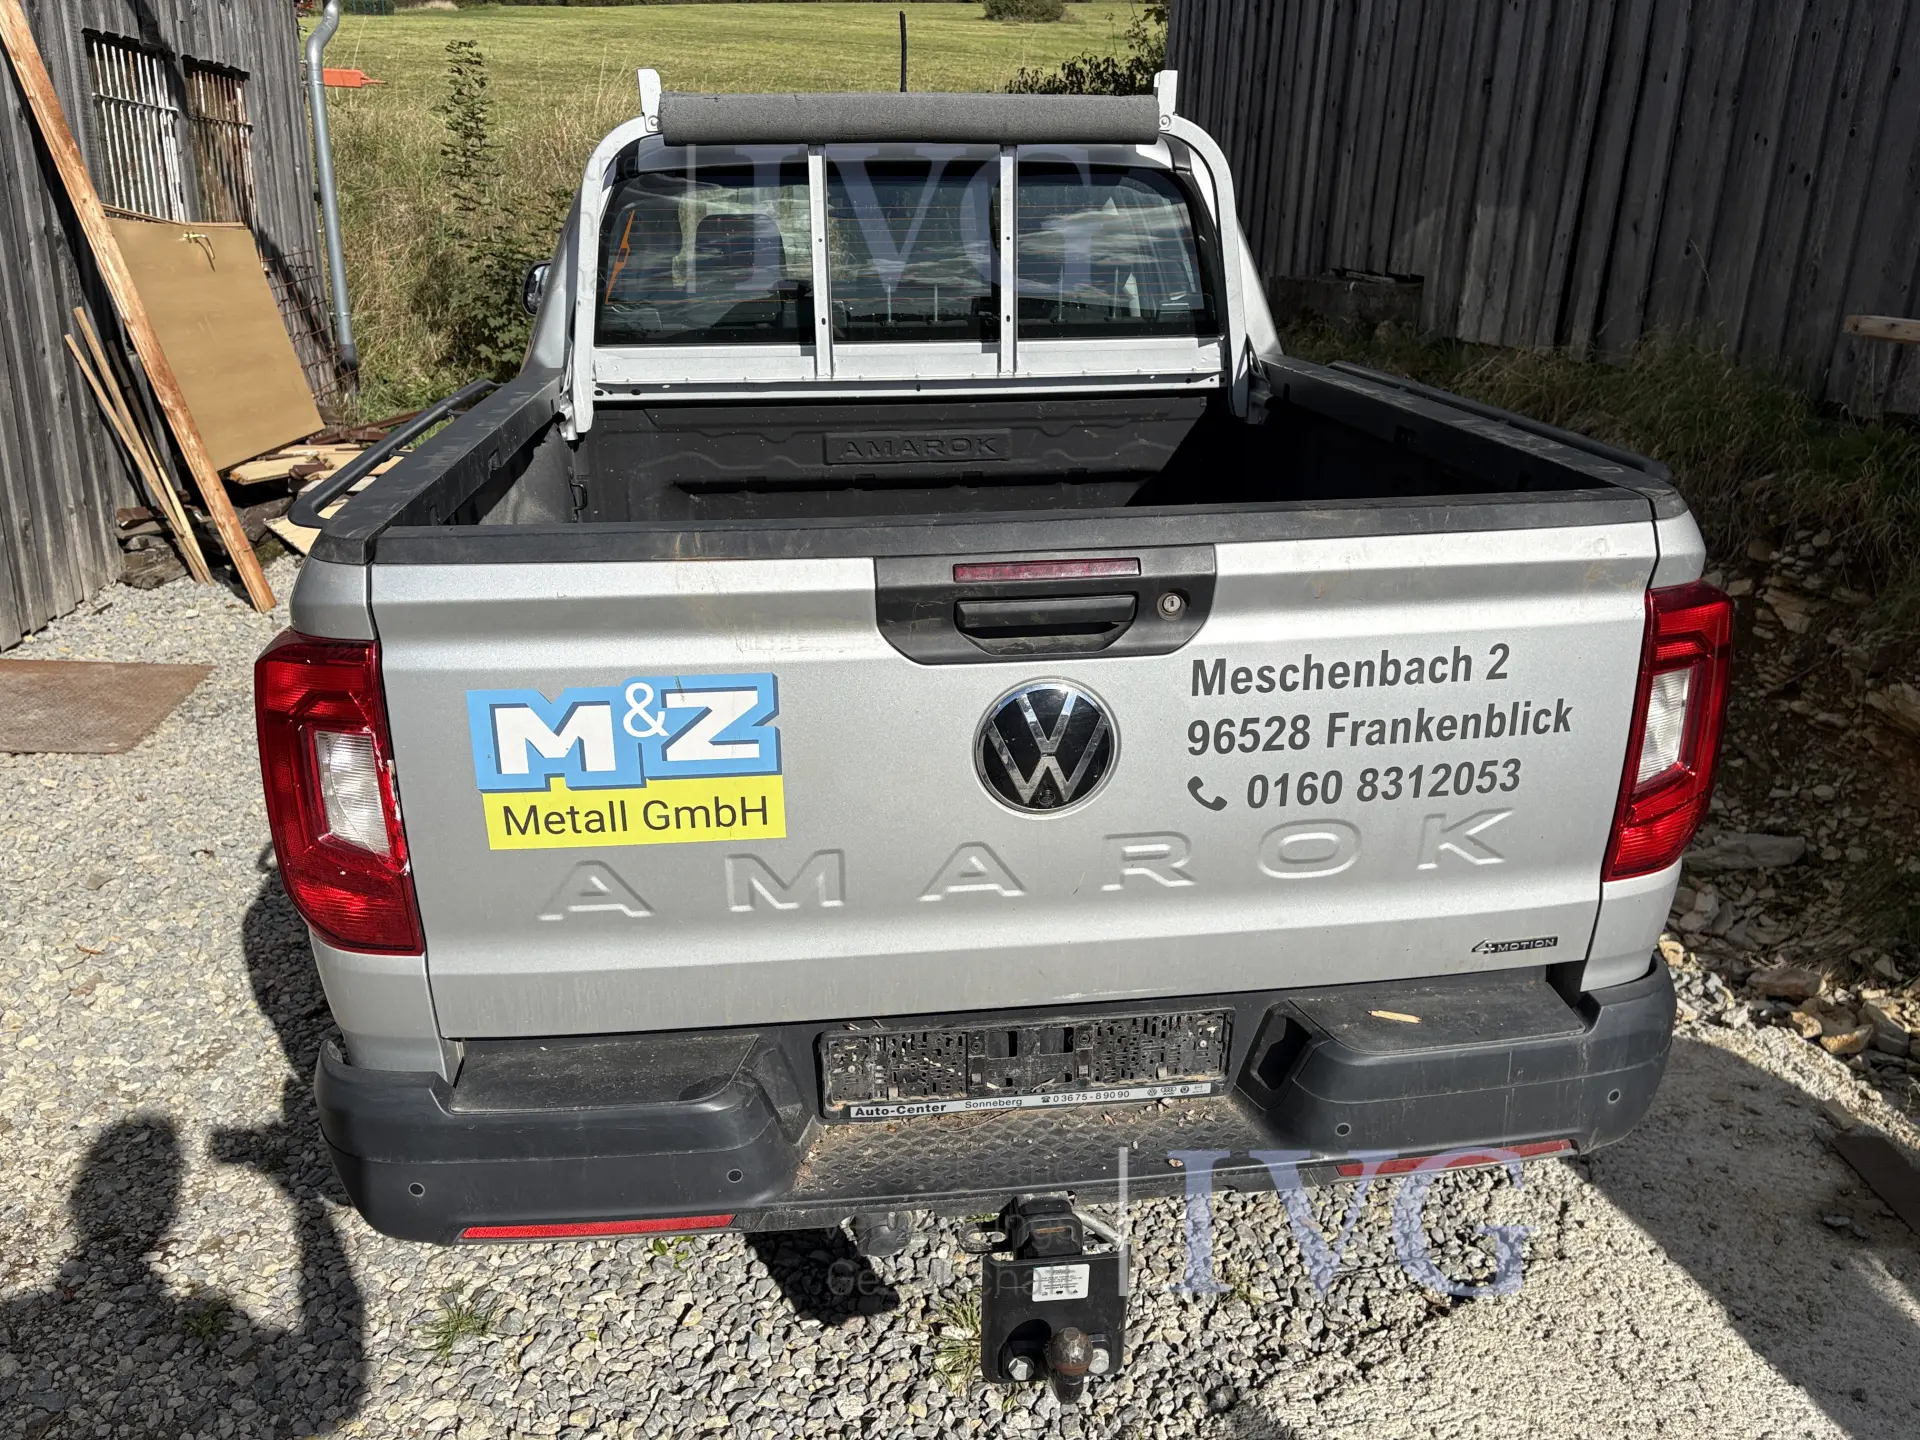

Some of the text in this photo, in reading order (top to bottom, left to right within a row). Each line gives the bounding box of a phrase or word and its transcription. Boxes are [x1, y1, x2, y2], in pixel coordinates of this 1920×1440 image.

[838, 437, 998, 460] AMAROK
[1191, 643, 1511, 697] Meschenbach 2
[488, 682, 761, 775] M&Z
[1187, 699, 1574, 756] 96528 Frankenblick
[1246, 758, 1522, 809] 0160 8312053
[502, 795, 769, 836] Metall GmbH
[538, 806, 1515, 922] AMAROK
[1471, 937, 1556, 954] 4MOTION
[855, 1104, 947, 1117] Auto-Center
[965, 1098, 1023, 1109] Sonneberg
